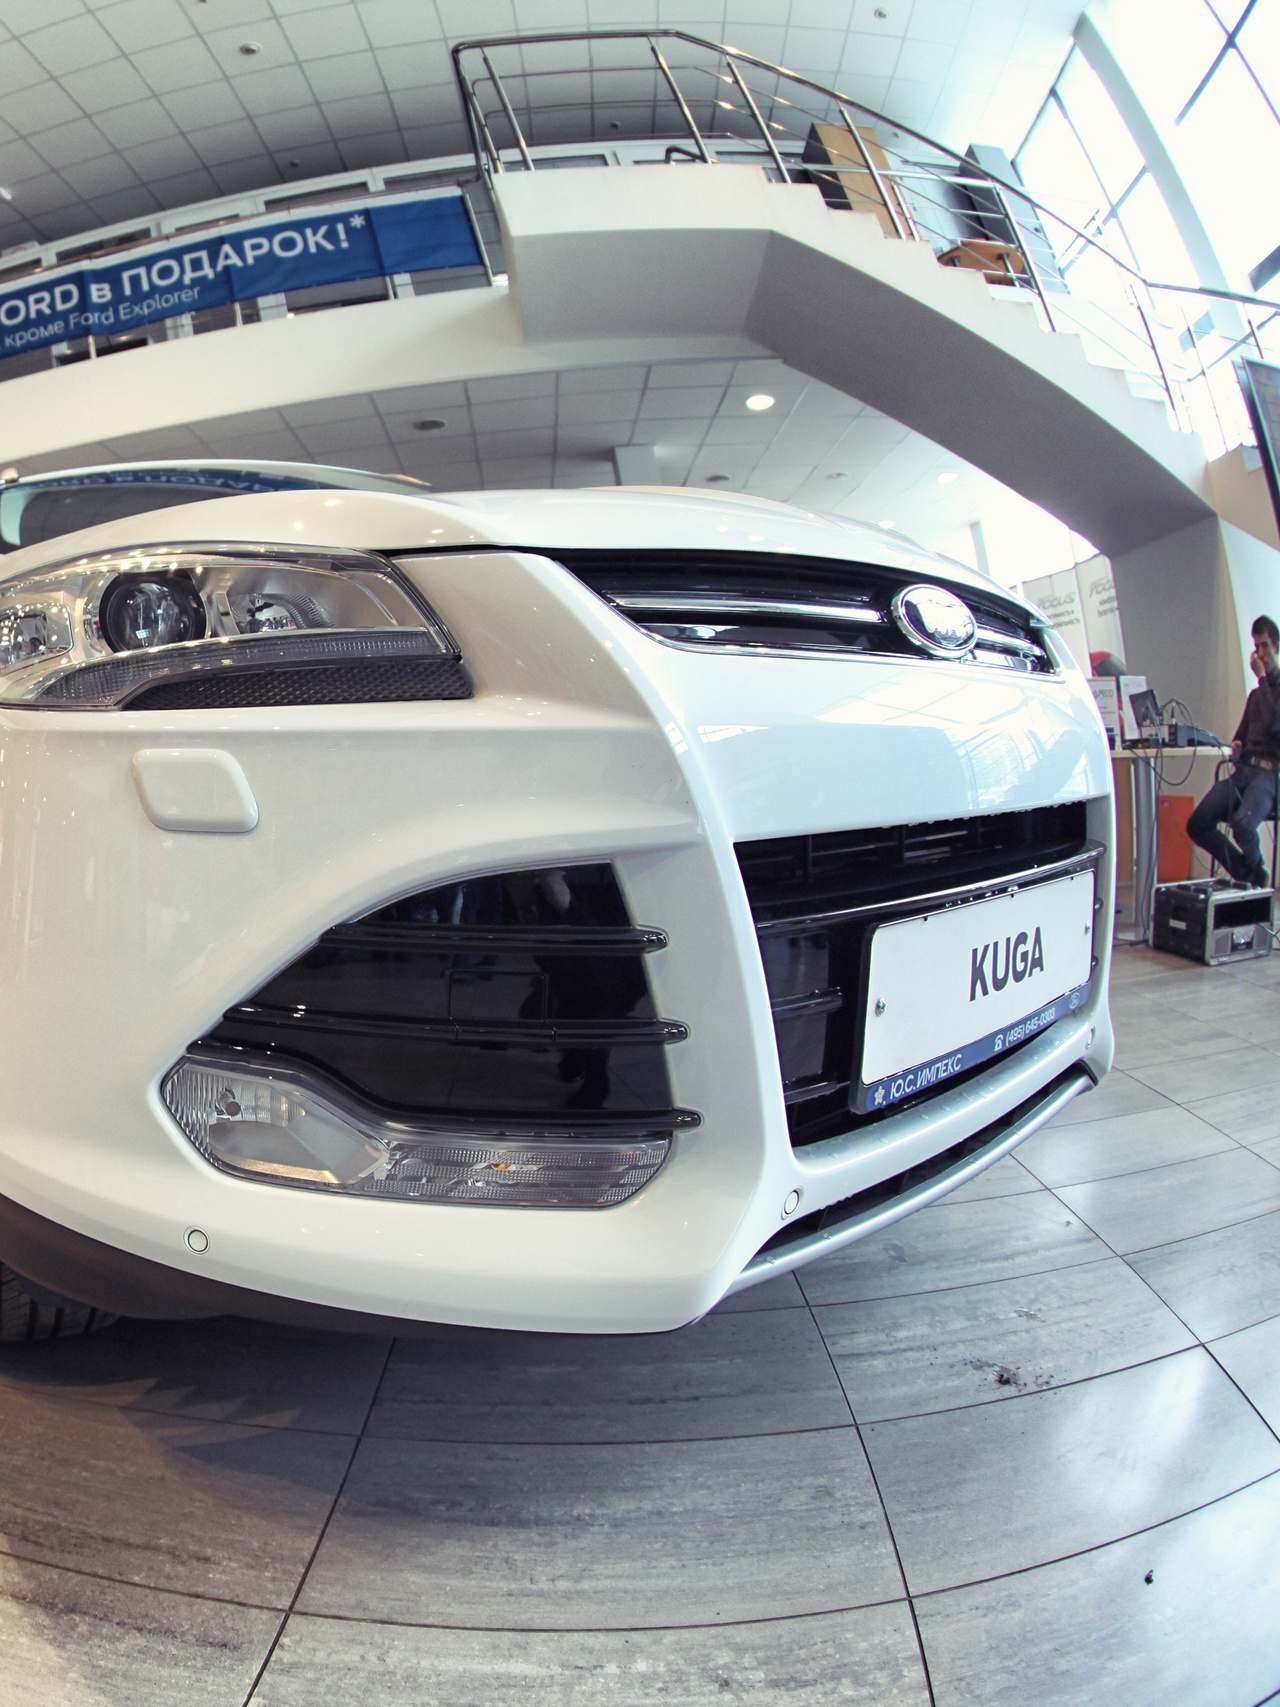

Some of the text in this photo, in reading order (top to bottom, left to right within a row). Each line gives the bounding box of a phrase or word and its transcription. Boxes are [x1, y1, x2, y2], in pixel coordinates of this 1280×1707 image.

[90, 282, 113, 303] в
[4, 319, 64, 347] кроме
[68, 307, 115, 330] Ford
[119, 286, 201, 320] Explorer
[969, 926, 1045, 1002] KUGA
[1005, 1026, 1025, 1047] (495)
